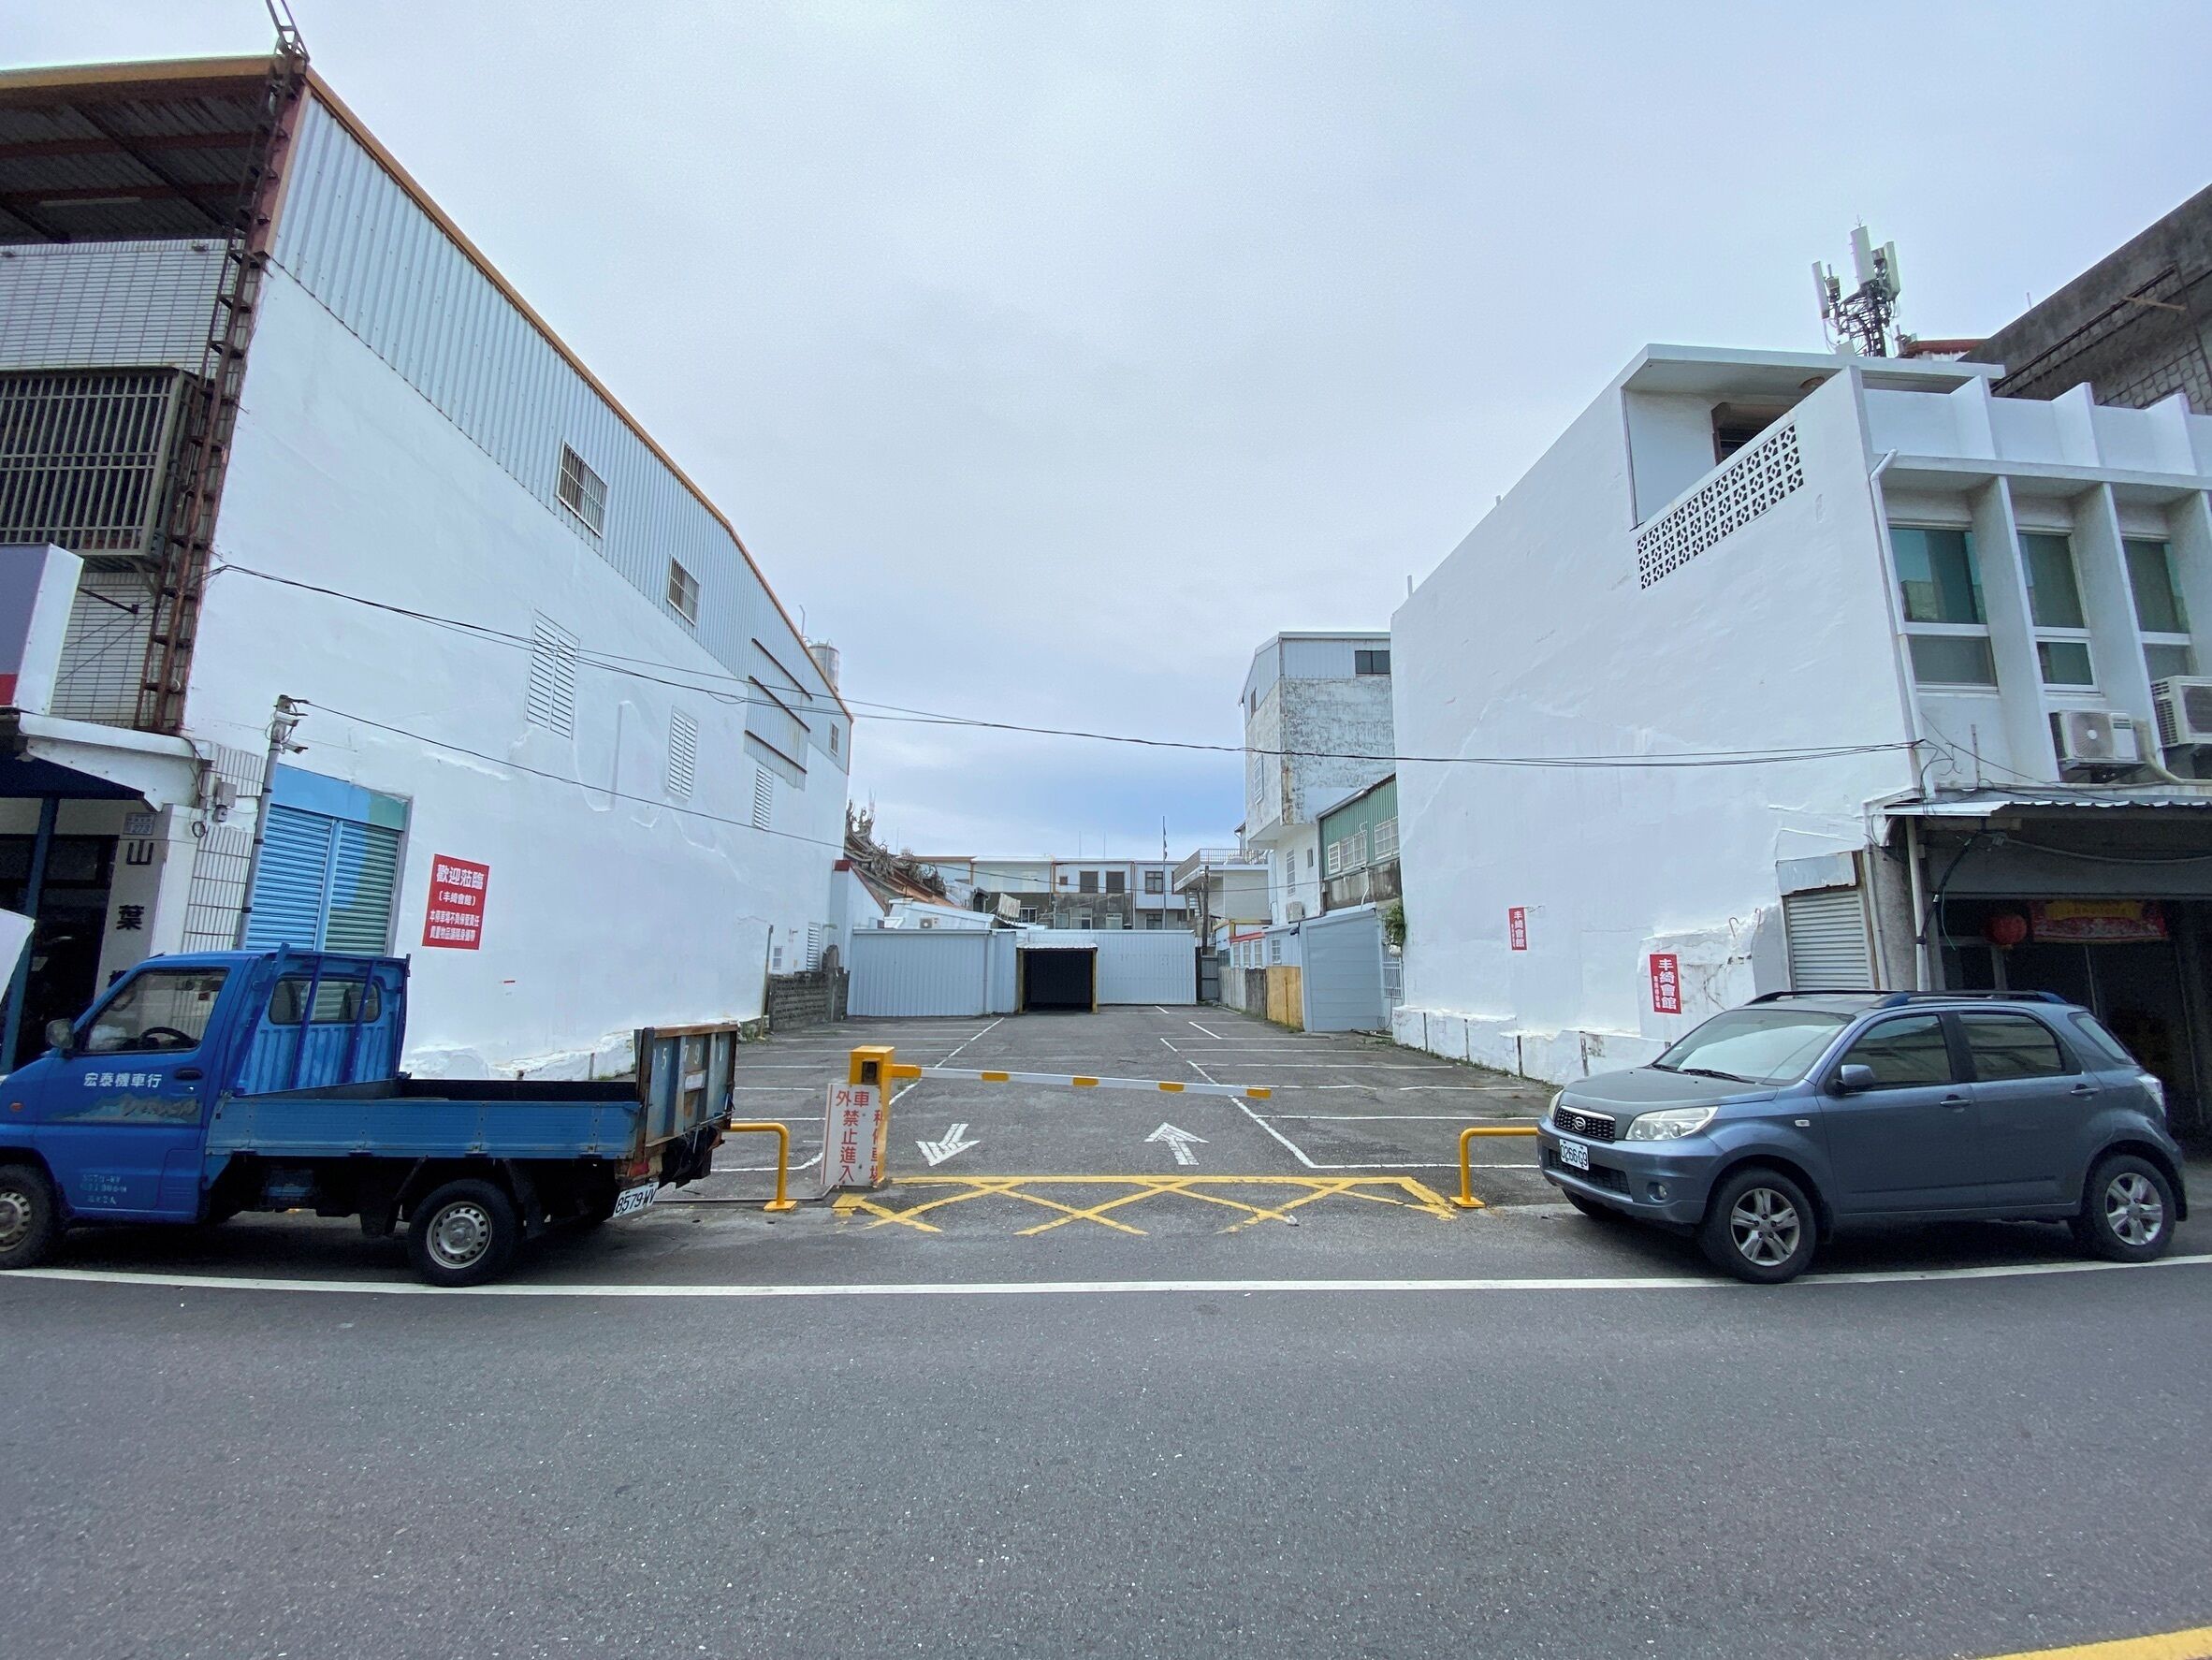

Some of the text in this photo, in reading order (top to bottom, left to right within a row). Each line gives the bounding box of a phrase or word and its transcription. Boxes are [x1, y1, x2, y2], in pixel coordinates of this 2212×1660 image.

[436, 864, 485, 890] 歡迎蒞臨
[1658, 958, 1677, 1010] 丰綺會館
[83, 1072, 162, 1088] 宏泰機車行
[836, 1090, 870, 1107] 外車
[838, 1109, 860, 1183] 禁止進入
